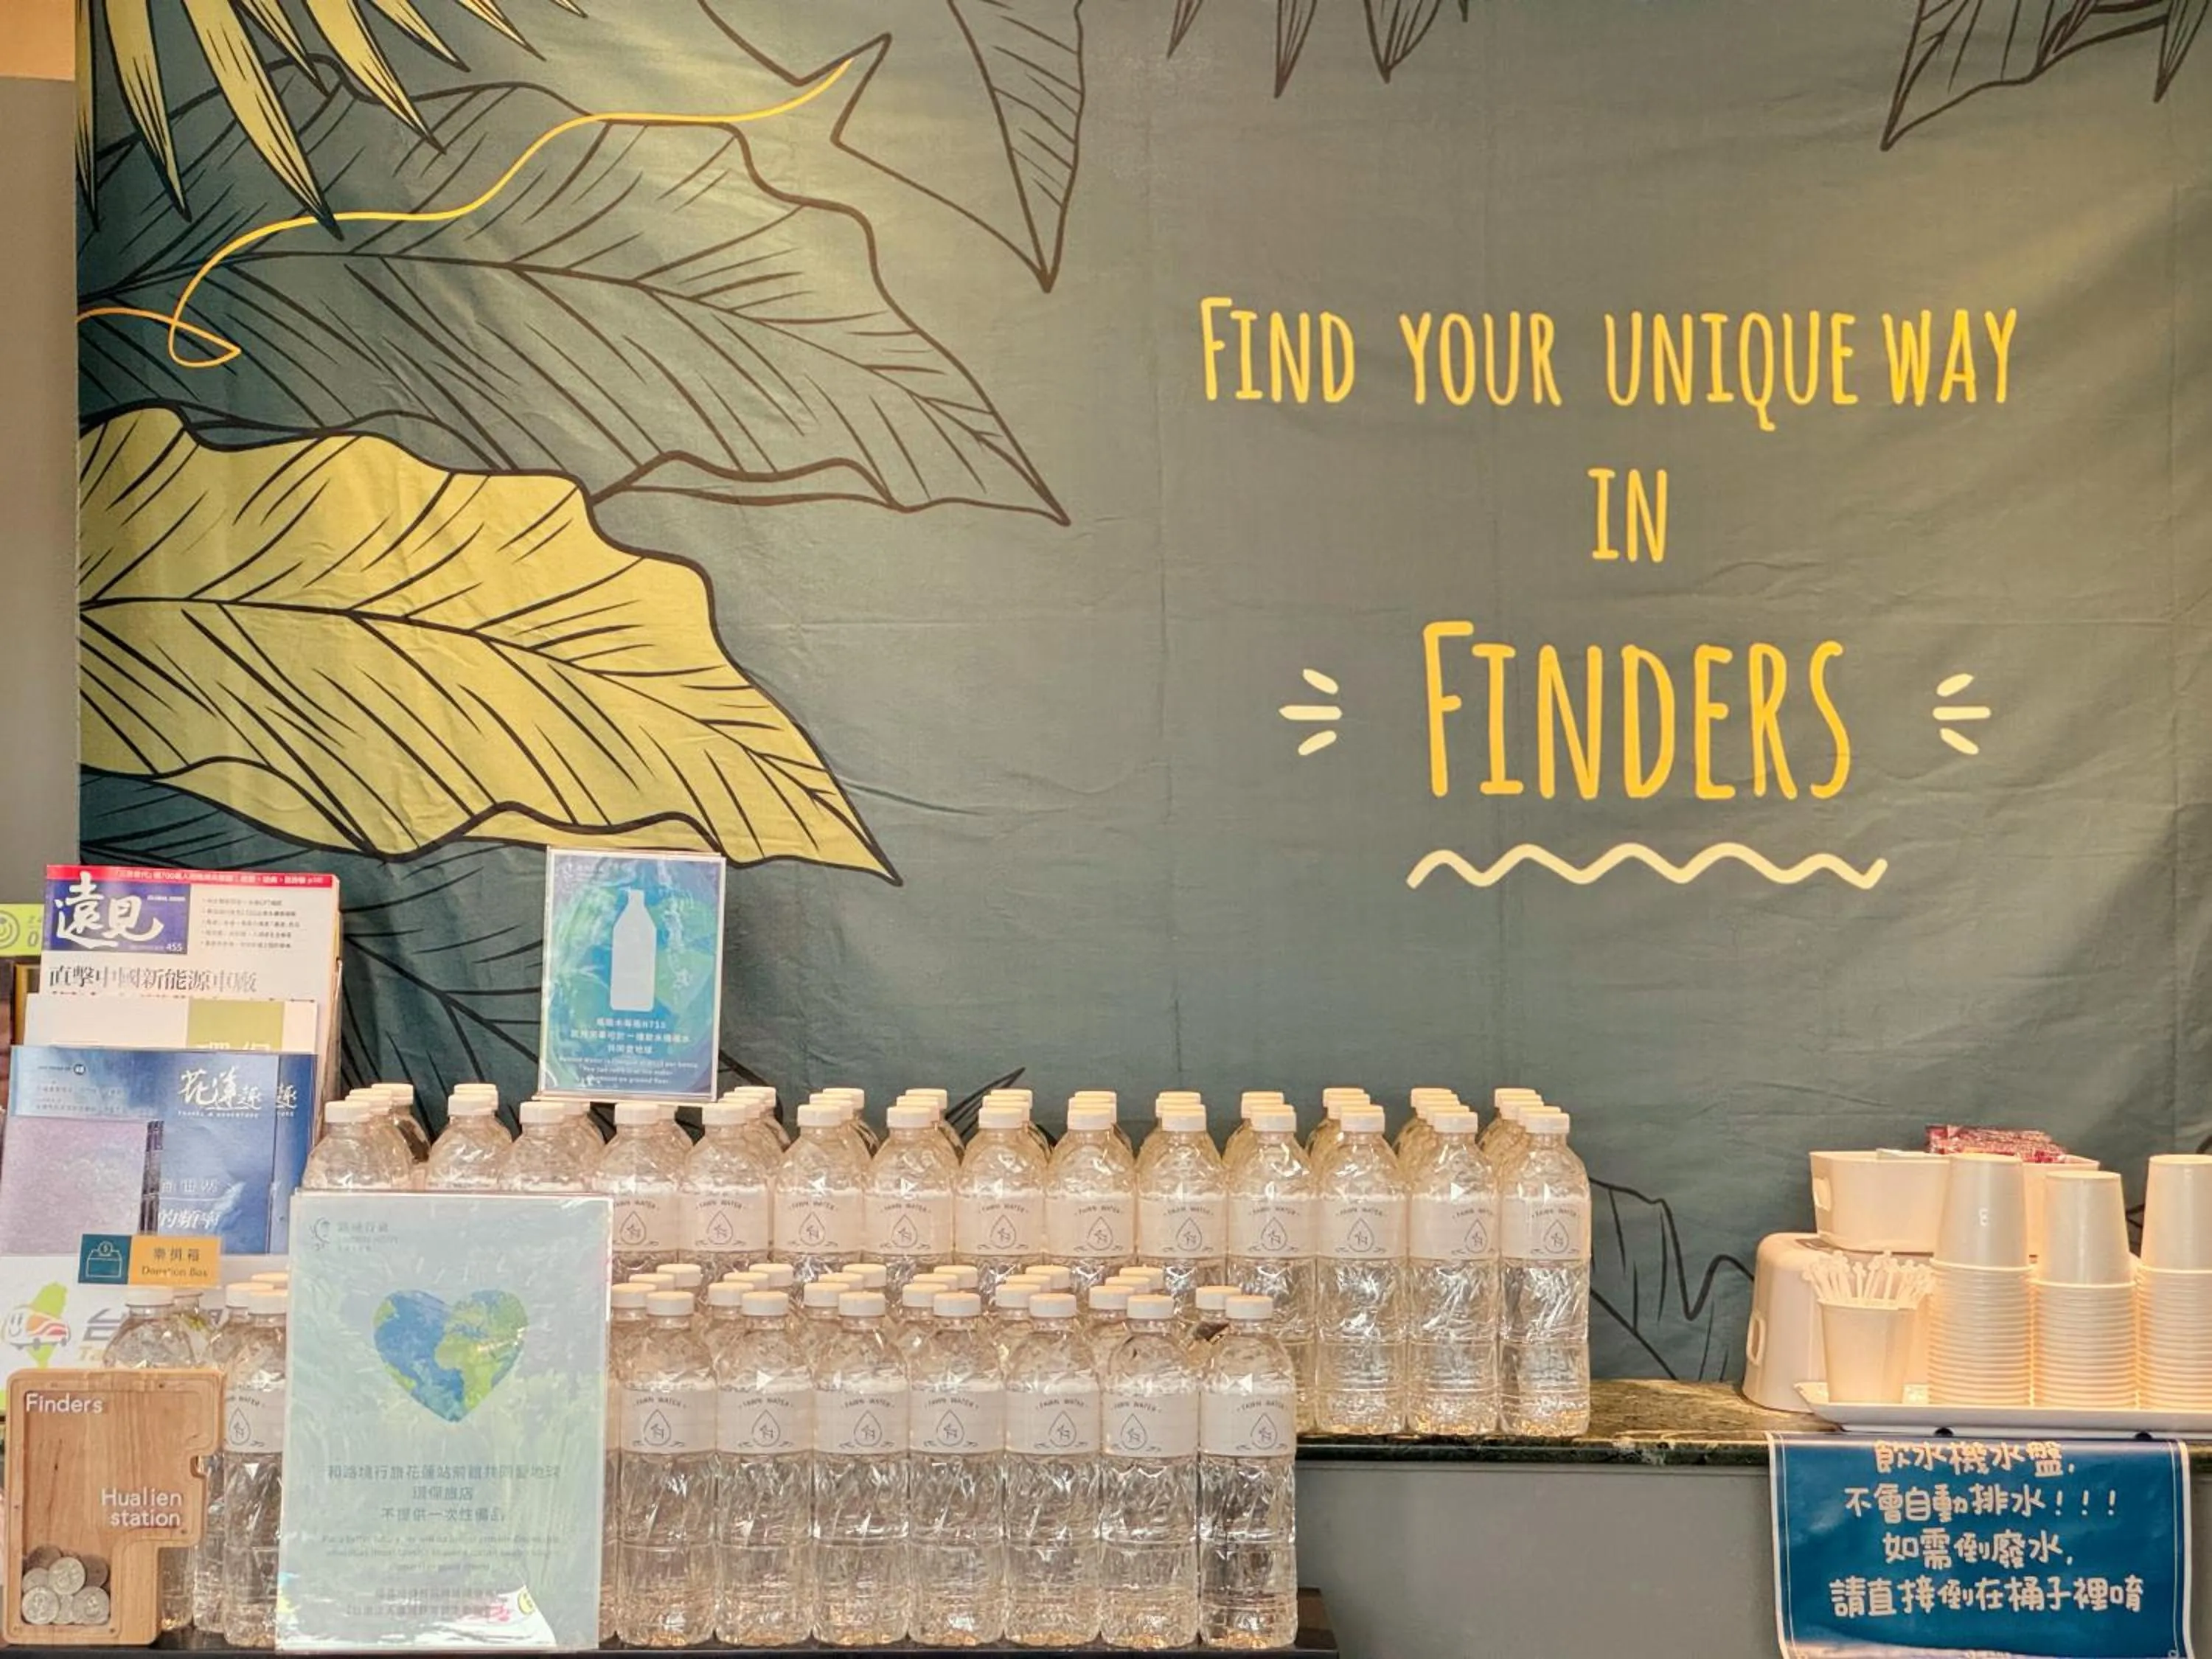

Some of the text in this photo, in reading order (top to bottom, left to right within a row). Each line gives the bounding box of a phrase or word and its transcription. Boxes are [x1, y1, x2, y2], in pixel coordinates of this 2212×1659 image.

[1200, 296, 2017, 432] FIND YOUR UNIQUE WAY
[1587, 467, 1669, 563] IN
[1423, 621, 1851, 799] FINDERS
[55, 872, 164, 949] 遠見
[166, 943, 183, 953] 455
[25, 1392, 103, 1413] Finders
[100, 1486, 181, 1506] Hualien
[110, 1509, 181, 1527] station
[1829, 1574, 2143, 1618] 請直接倒在桶子裡唷
